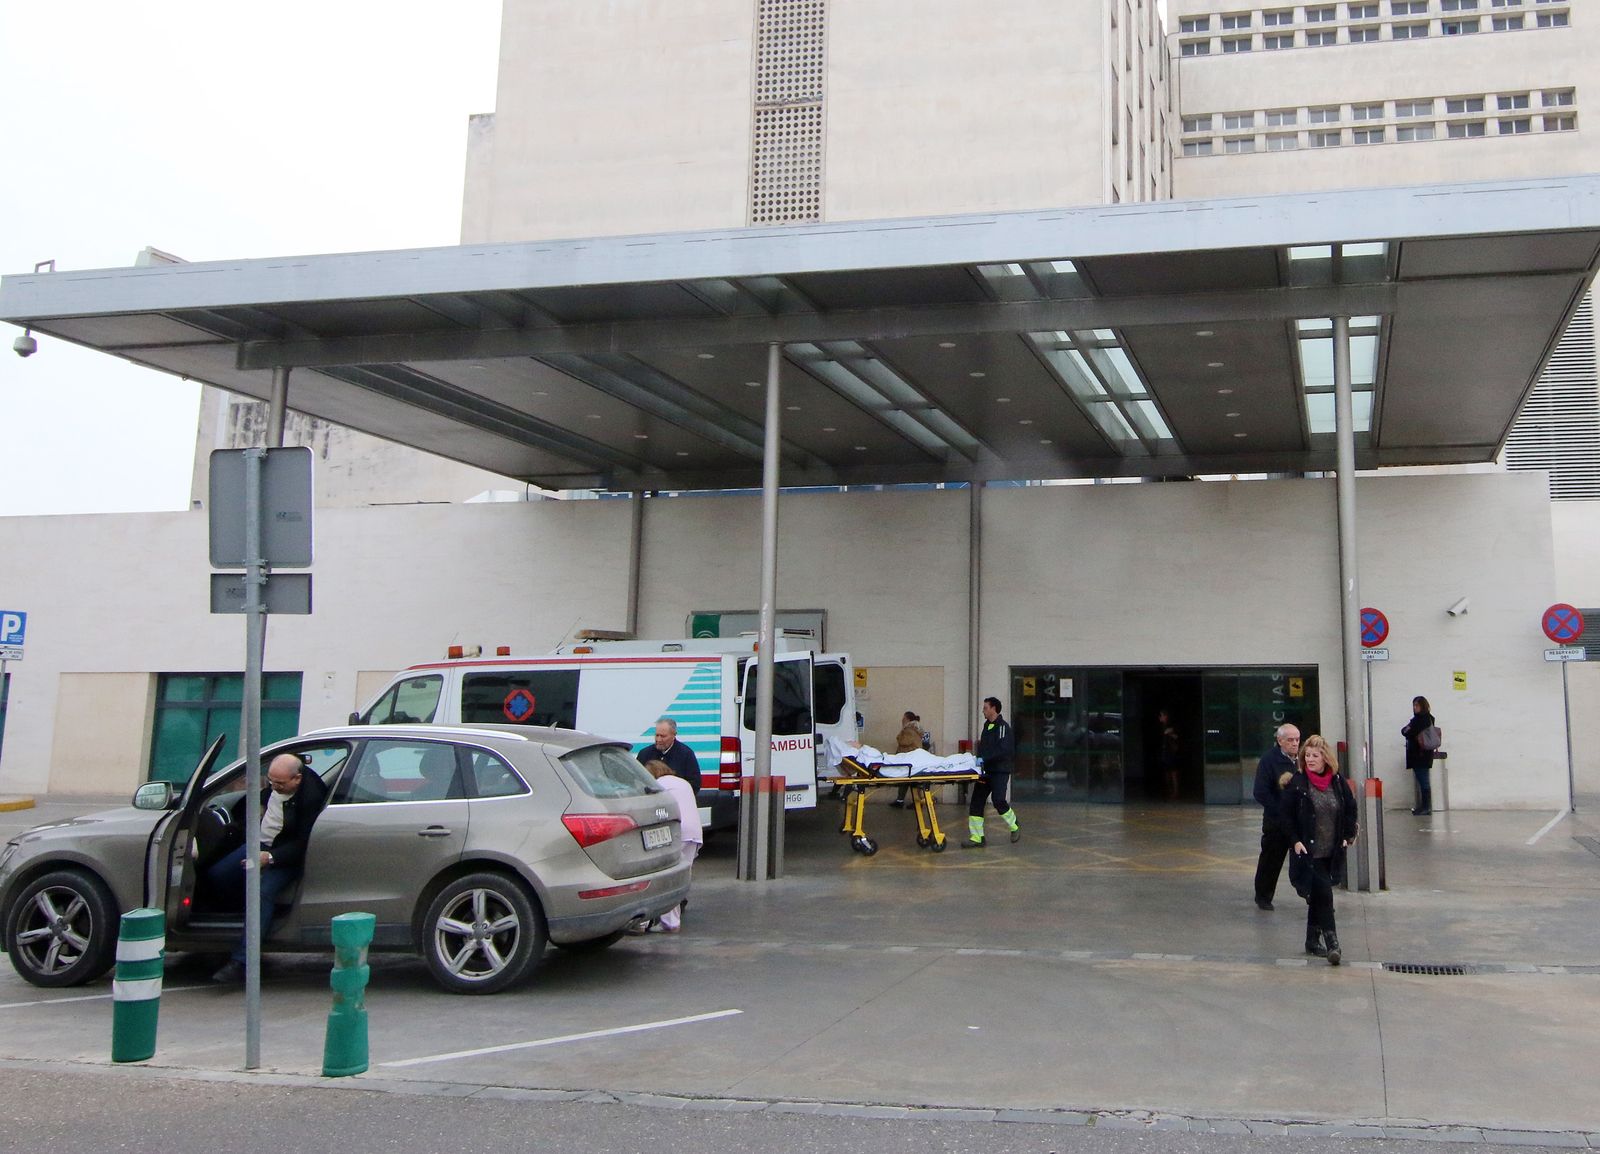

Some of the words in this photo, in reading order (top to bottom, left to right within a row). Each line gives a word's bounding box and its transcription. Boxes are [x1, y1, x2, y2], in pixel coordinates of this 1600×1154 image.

[1, 614, 21, 641] P
[770, 738, 814, 752] AMBUL
[1043, 673, 1056, 795] URGENCIAS
